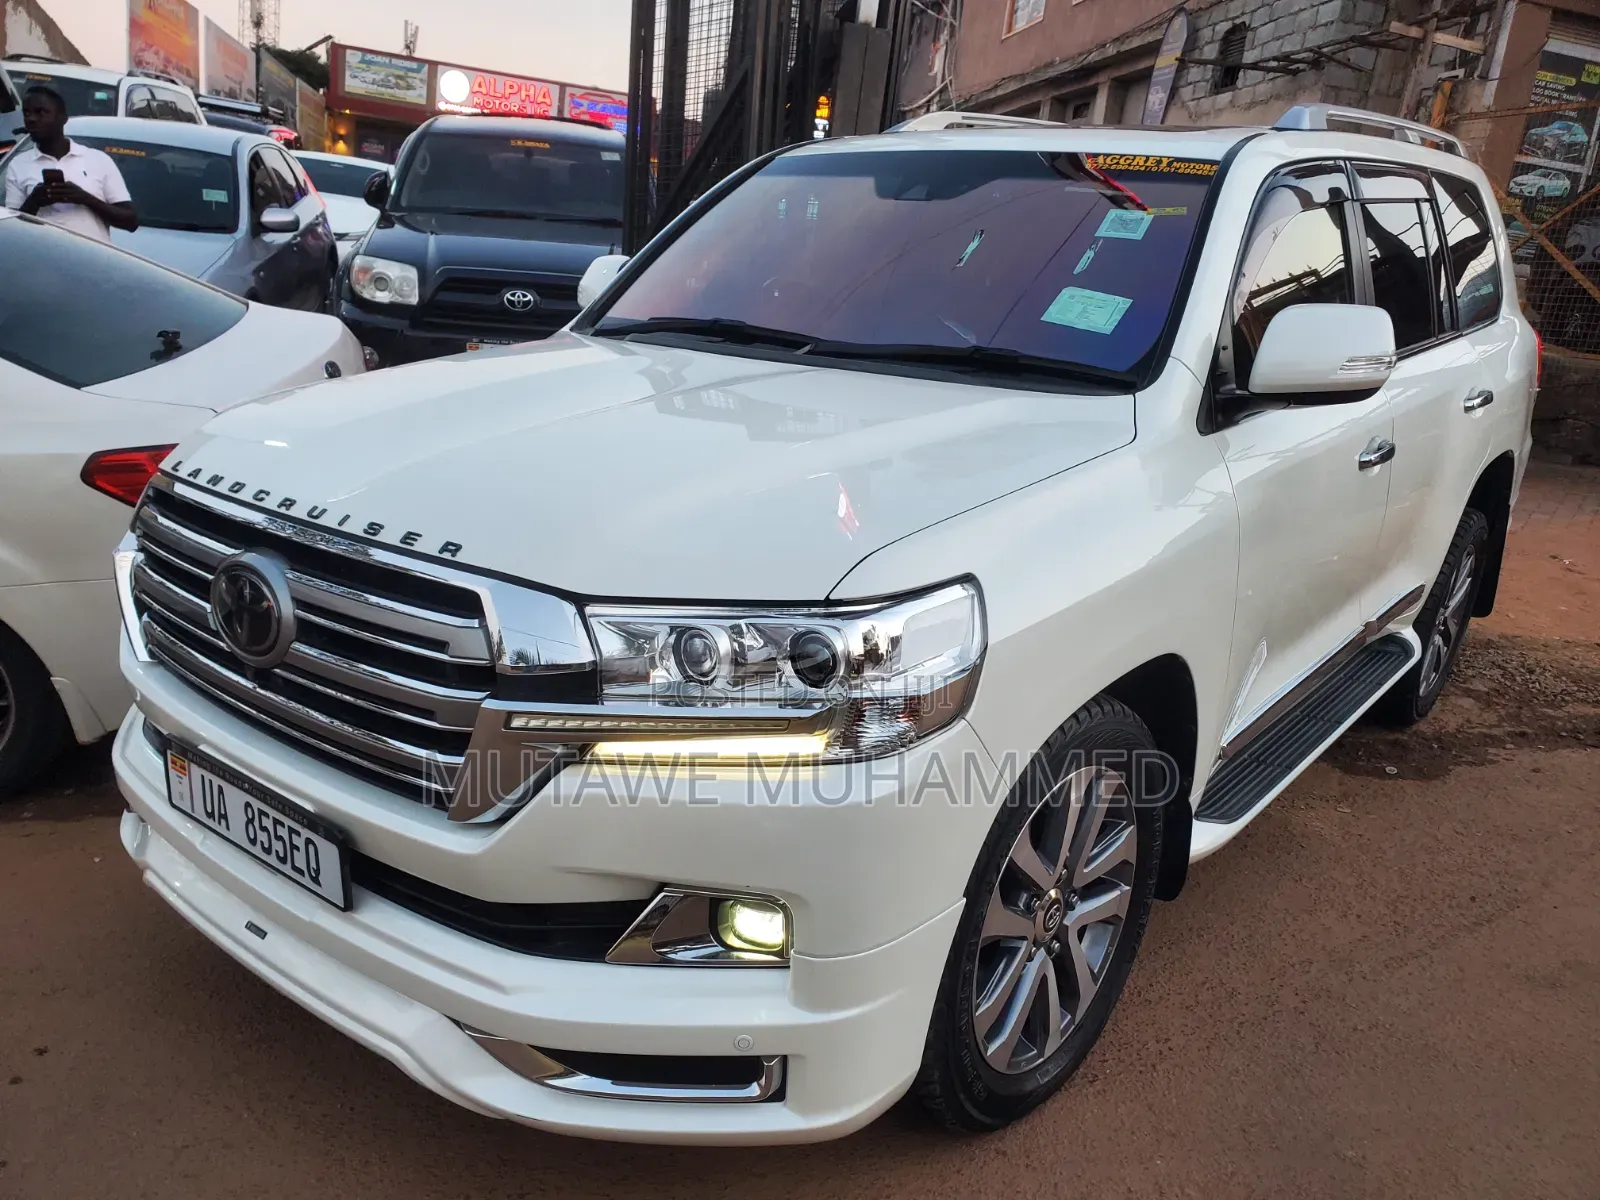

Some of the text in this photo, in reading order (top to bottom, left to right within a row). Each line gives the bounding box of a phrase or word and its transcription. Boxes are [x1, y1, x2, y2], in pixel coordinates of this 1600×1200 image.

[471, 74, 552, 106] ALPHA
[473, 96, 527, 114] MOTORS
[1089, 155, 1219, 171] AGGREY MOTORS
[170, 460, 464, 557] LANDCRUISER
[200, 773, 323, 888] UA 855EQ
